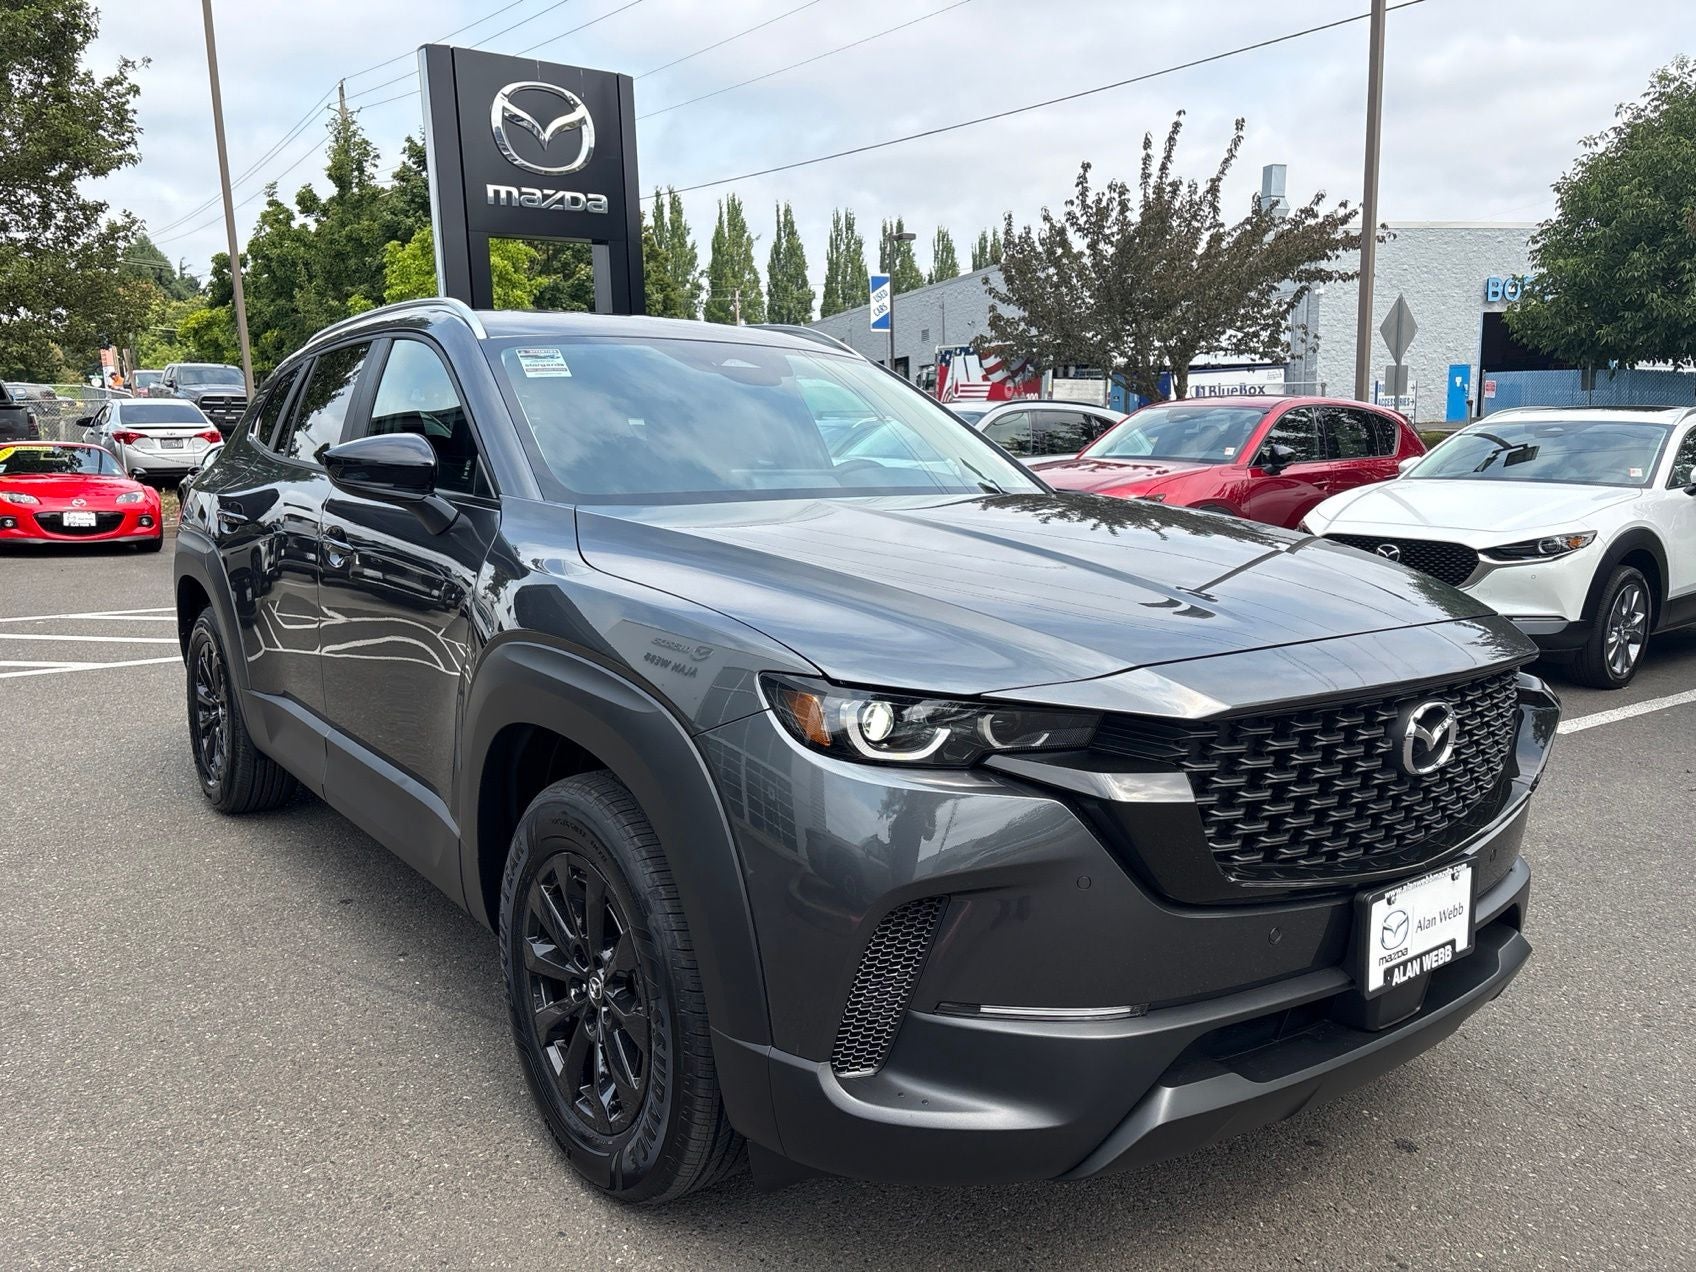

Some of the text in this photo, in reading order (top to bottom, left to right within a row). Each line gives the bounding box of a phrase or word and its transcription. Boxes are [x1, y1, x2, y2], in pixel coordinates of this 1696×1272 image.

[873, 289, 888, 303] USED
[873, 302, 888, 316] CARS
[1209, 383, 1266, 396] BlueBox
[1378, 397, 1410, 407] ACCESSRIES
[1415, 903, 1464, 934] Alan Webb
[1378, 947, 1409, 967] mazda
[1391, 944, 1453, 987] ALAN WEBB
